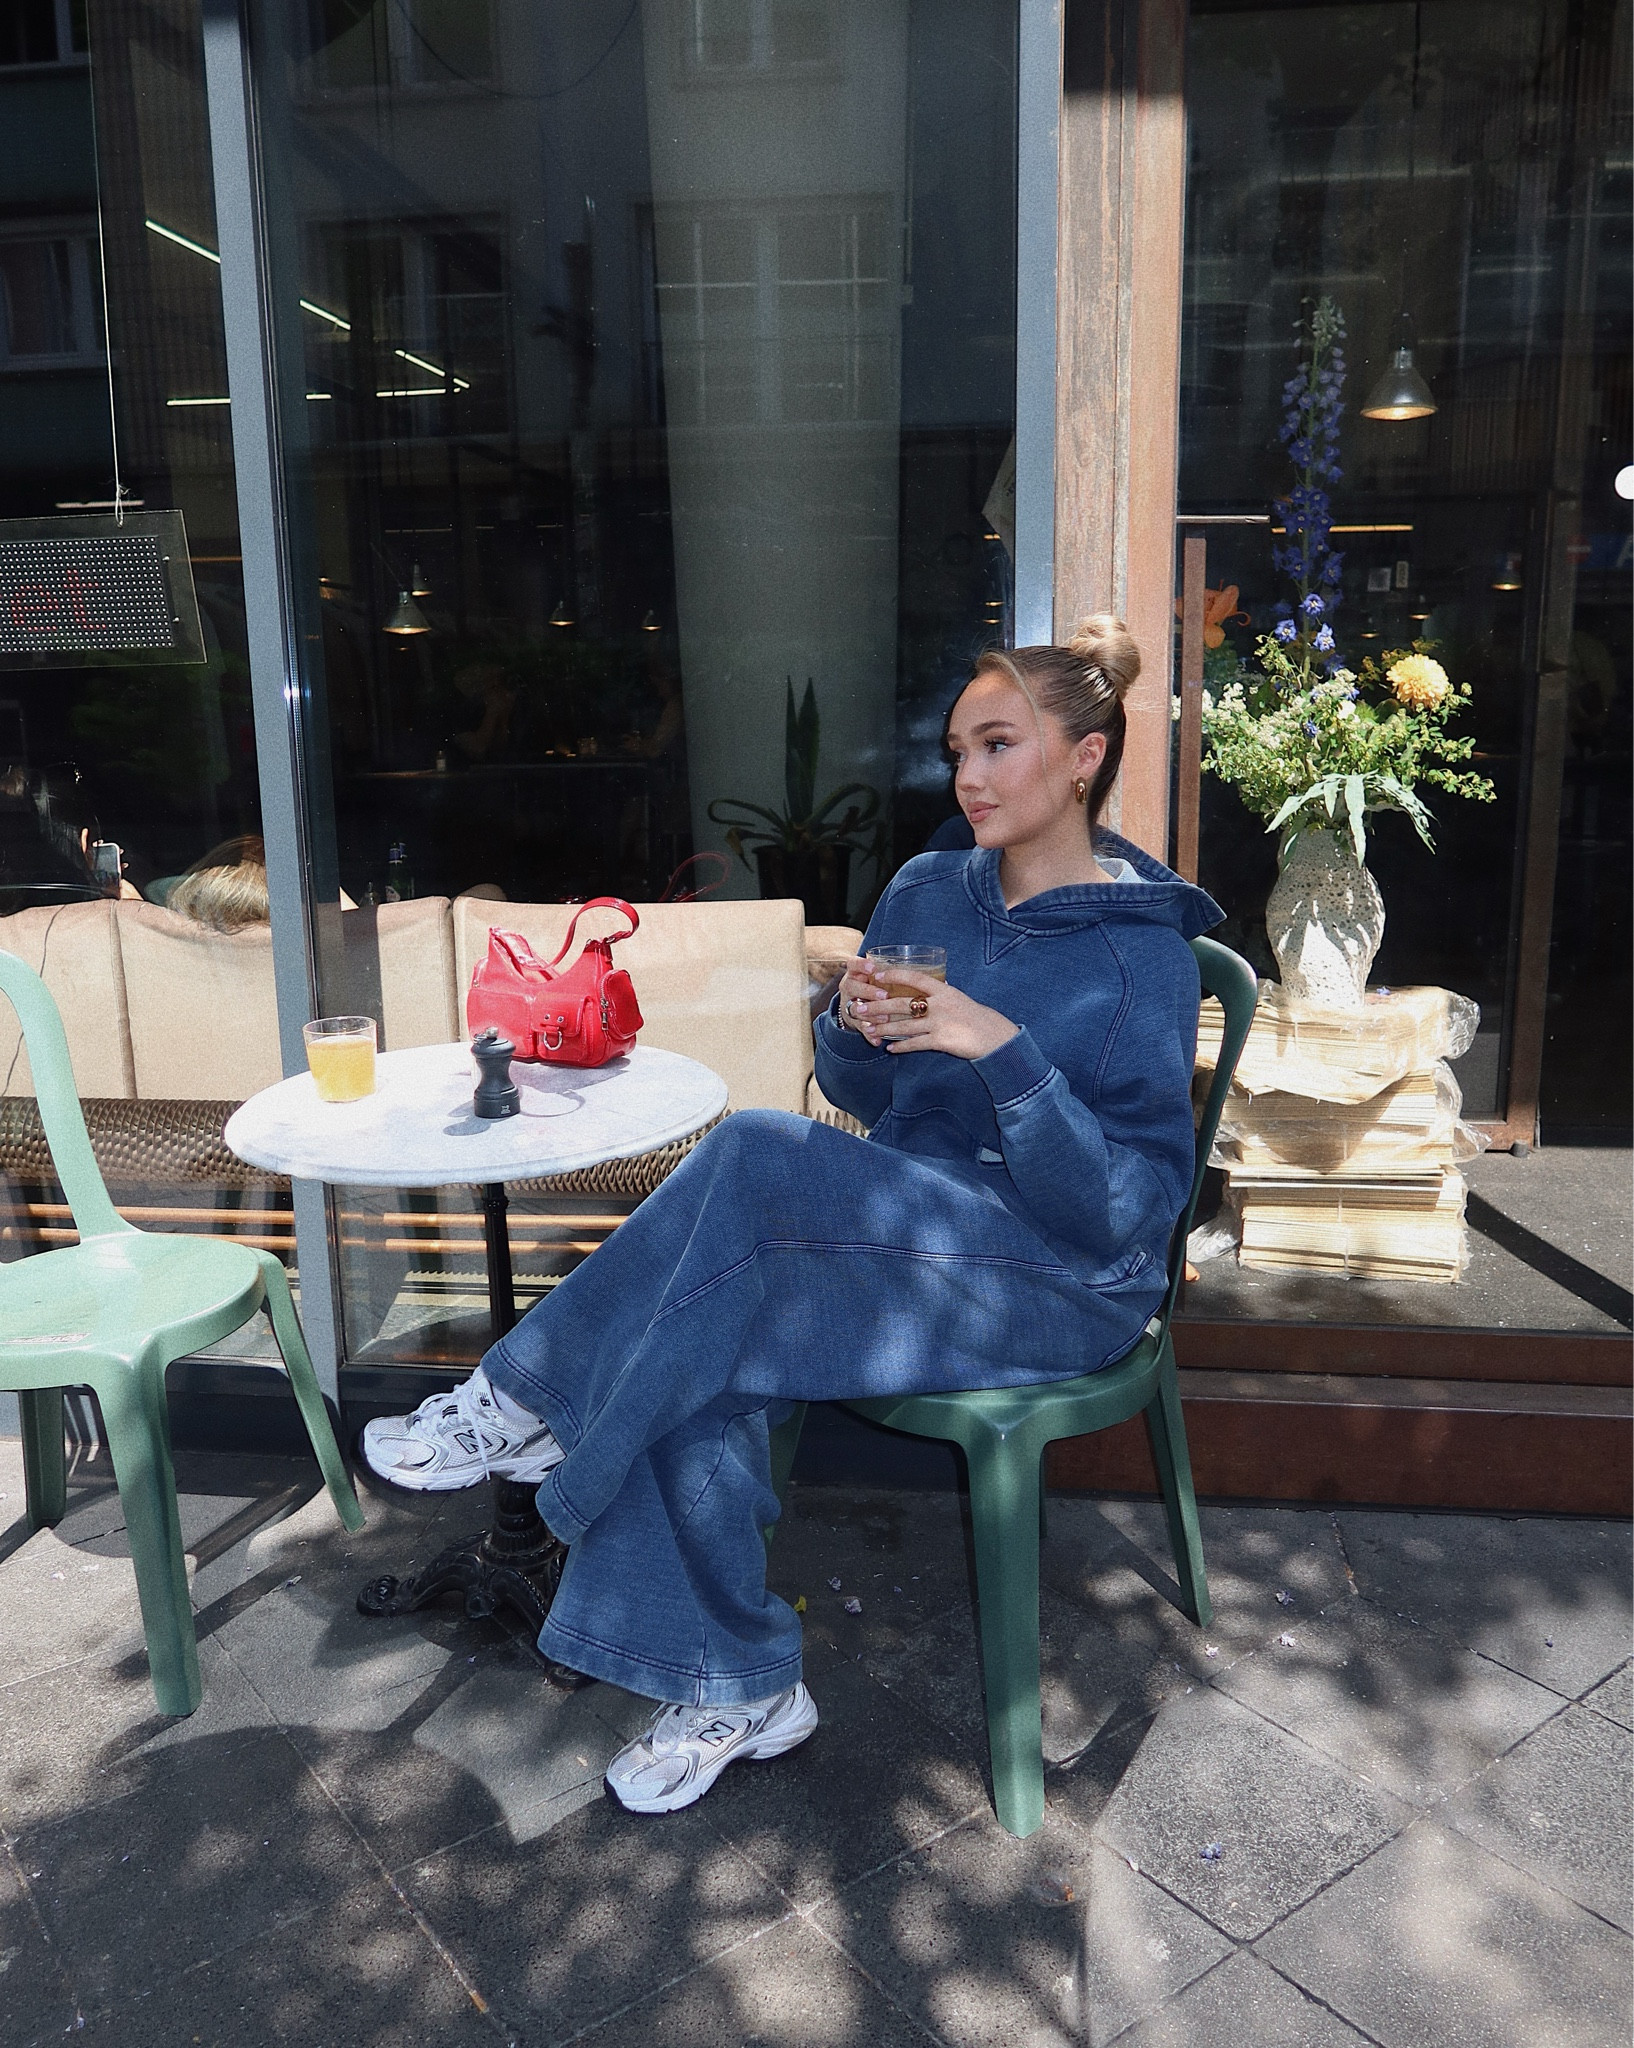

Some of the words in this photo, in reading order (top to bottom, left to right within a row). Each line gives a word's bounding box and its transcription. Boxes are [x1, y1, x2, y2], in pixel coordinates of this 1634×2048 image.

[0, 569, 107, 632] et
[454, 1428, 493, 1454] N
[698, 1720, 736, 1747] N
